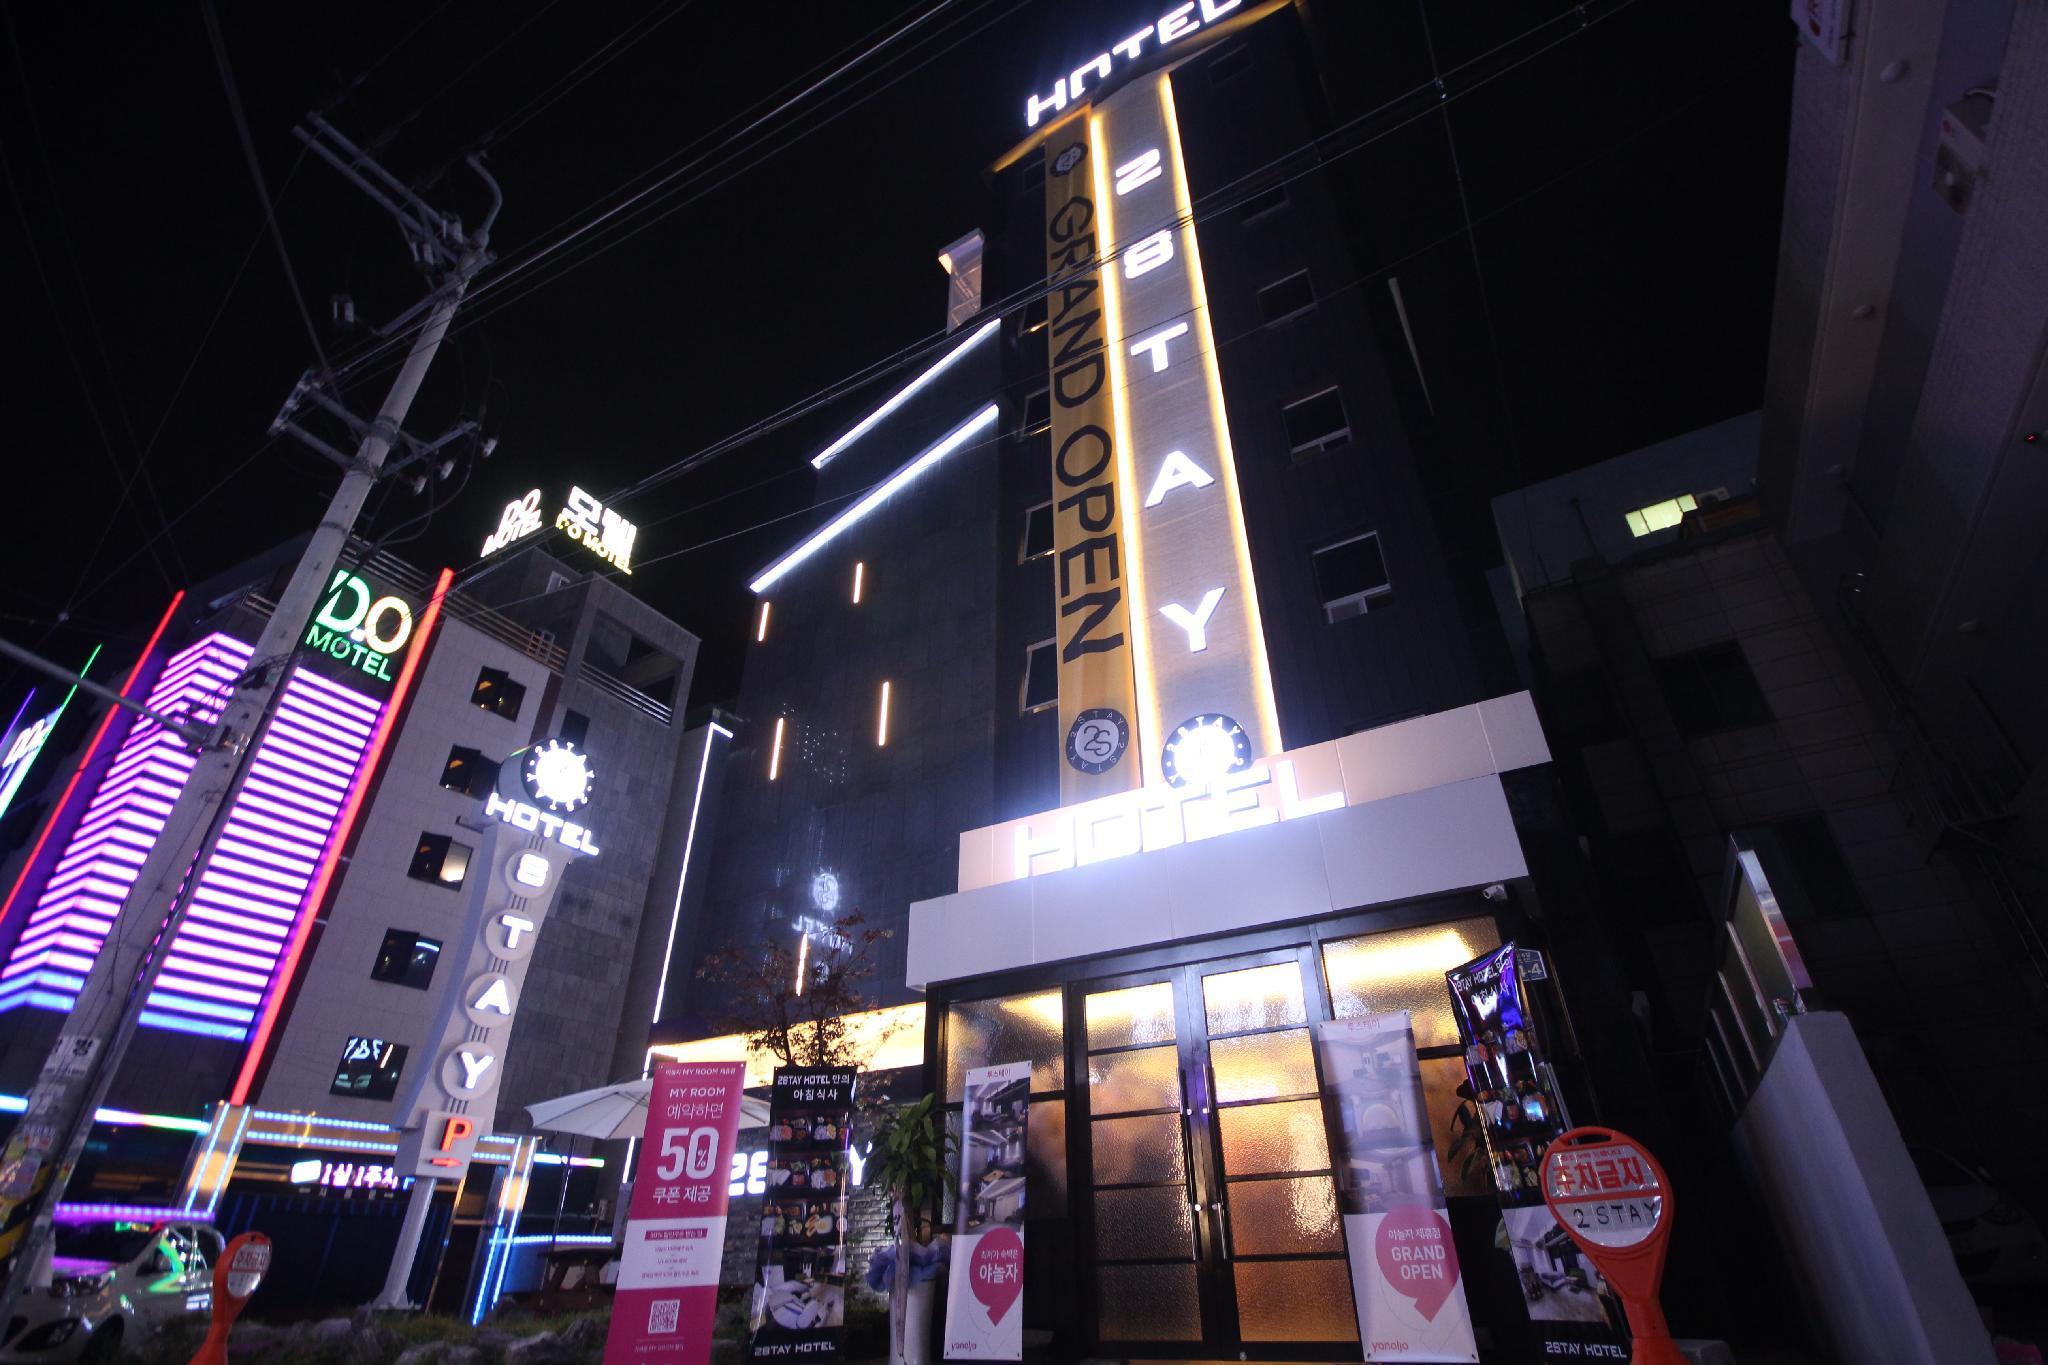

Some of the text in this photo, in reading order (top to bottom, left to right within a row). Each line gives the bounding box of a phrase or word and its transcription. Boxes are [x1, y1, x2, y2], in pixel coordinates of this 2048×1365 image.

[1027, 0, 1242, 127] HOTEL
[1050, 196, 1124, 664] GRAND OPEN
[305, 623, 391, 682] MOTEL
[485, 792, 600, 857] HOTEL
[1014, 760, 1347, 880] HOTEL
[803, 1074, 831, 1085] HOTEL
[670, 1087, 726, 1099] MY ROOM
[667, 1102, 724, 1120] 예약하면
[441, 1117, 474, 1152] P
[1552, 1156, 1647, 1193] 주차금지
[652, 1185, 712, 1204] 쿠폰 제공
[1388, 1228, 1413, 1241] 야놀자
[1391, 1245, 1446, 1261] GRAND
[979, 1262, 1018, 1284] 야놀자
[1400, 1263, 1443, 1280] OPEN
[795, 1341, 836, 1354] HOTEL
[1584, 1343, 1628, 1358] HOTEL
